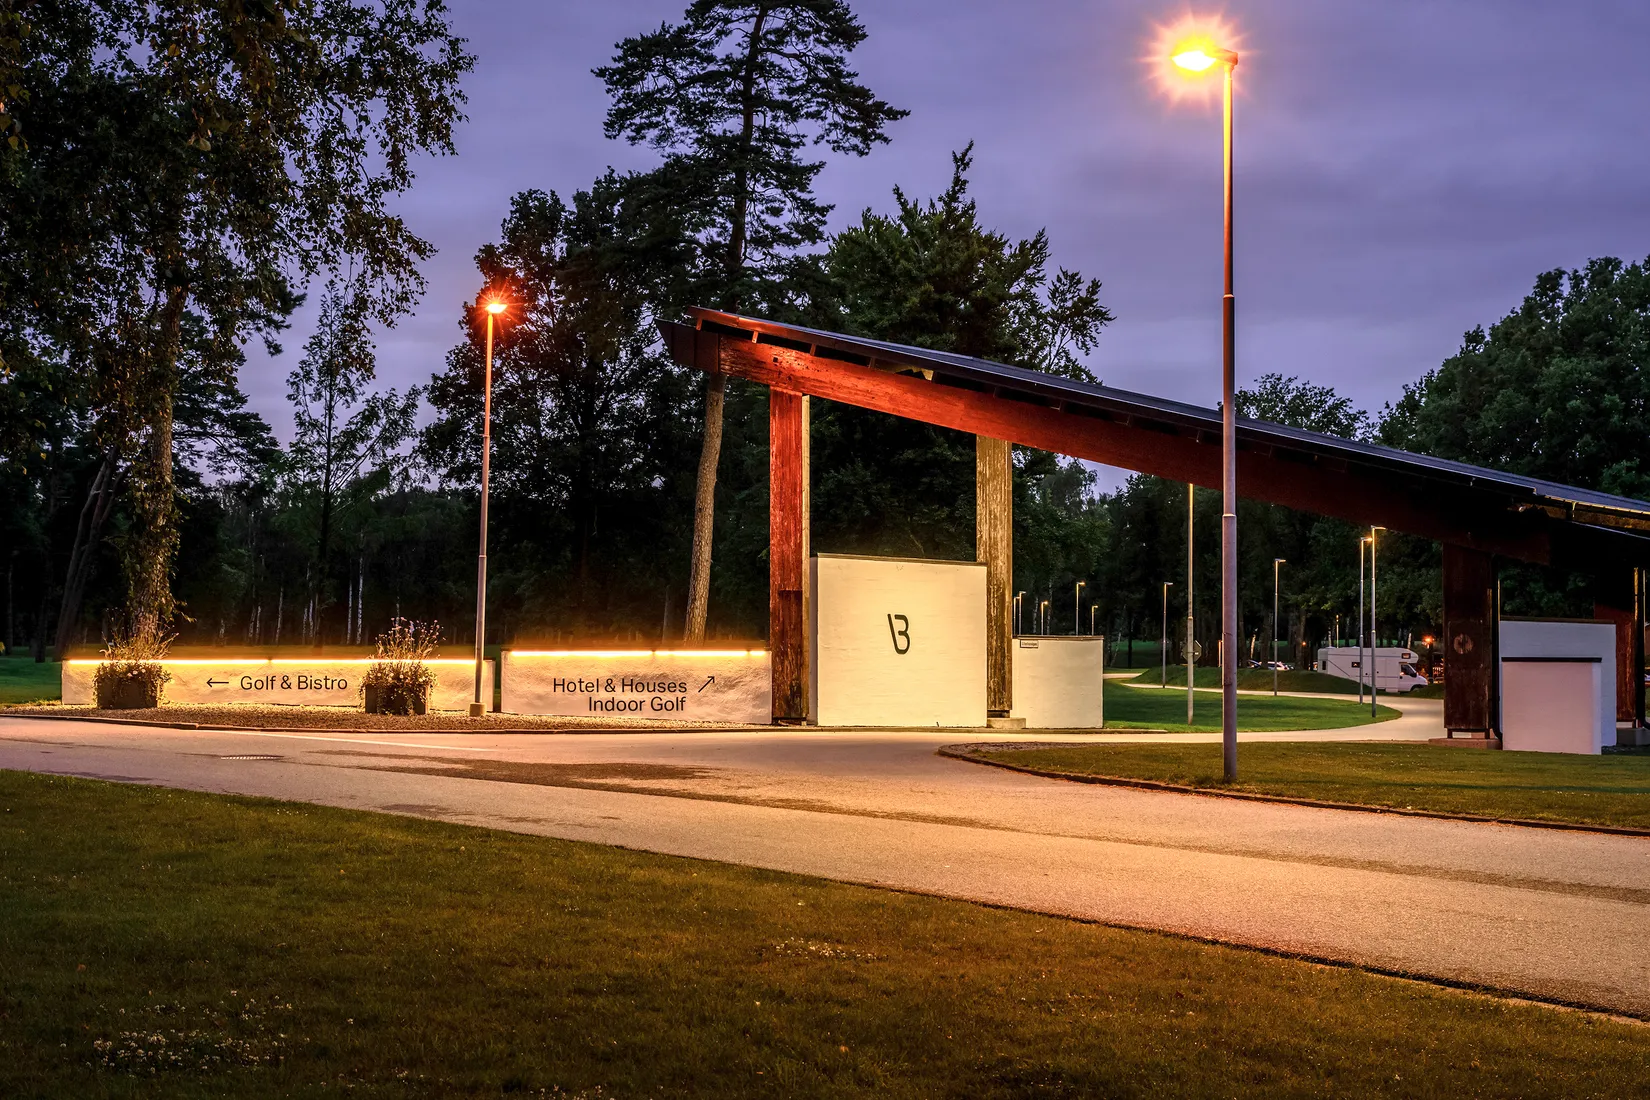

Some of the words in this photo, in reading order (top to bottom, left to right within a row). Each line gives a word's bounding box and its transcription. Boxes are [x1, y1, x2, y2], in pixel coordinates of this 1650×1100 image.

[240, 675, 277, 690] Golf
[280, 675, 292, 690] &
[297, 675, 348, 690] Bistro
[553, 678, 599, 692] Hotel
[604, 678, 616, 692] &
[621, 678, 687, 693] Houses
[588, 696, 646, 712] Indoor
[650, 696, 687, 712] Golf
